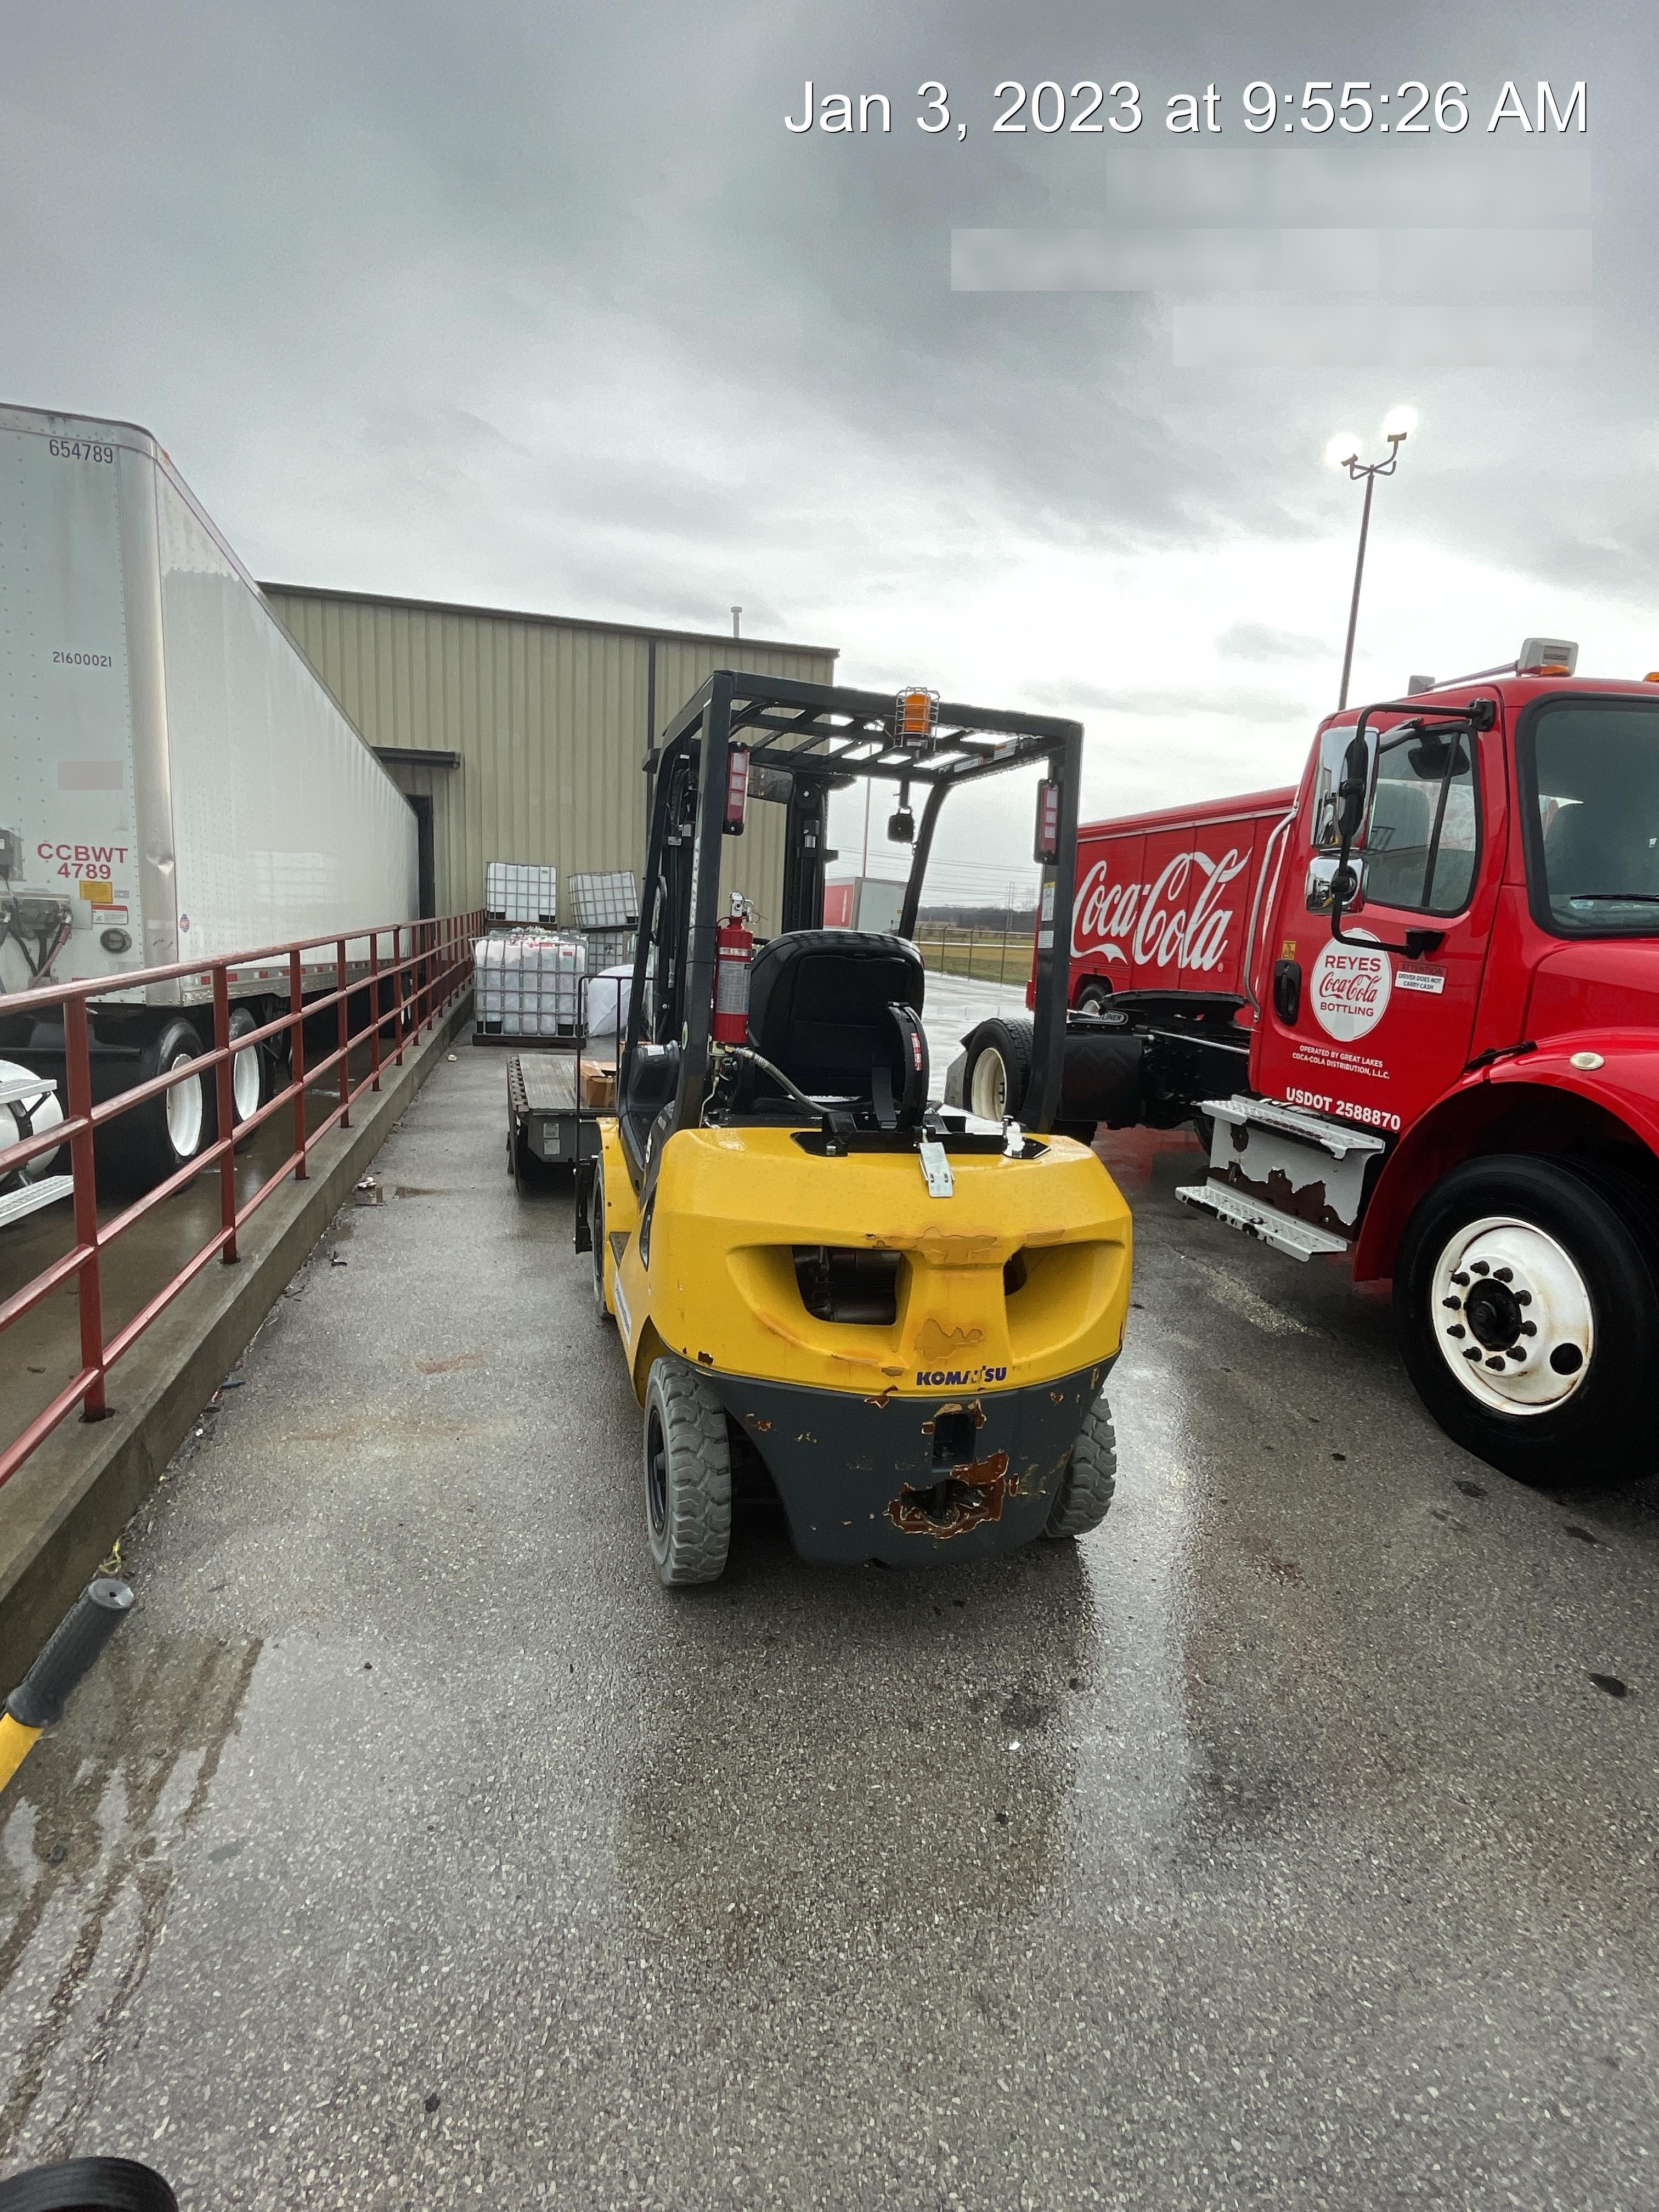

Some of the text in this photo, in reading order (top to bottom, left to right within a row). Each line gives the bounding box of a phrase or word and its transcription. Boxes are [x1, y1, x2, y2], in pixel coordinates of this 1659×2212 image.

[49, 439, 113, 464] 654789
[53, 651, 112, 667] 21600021
[37, 843, 128, 863] CCBWT
[57, 862, 111, 879] 4789
[1070, 847, 1253, 971] Coca-Cola
[1325, 955, 1381, 972] REYES
[1319, 971, 1382, 1003] Coca-Cola
[1320, 1002, 1374, 1017] BOTTLING
[1293, 1052, 1325, 1065] COCA-COLA
[1327, 1059, 1371, 1076] DISTRIBUTION,
[1300, 1045, 1330, 1057] OPERATED
[1340, 1053, 1361, 1063] GREAT
[1362, 1057, 1383, 1068] LAKES
[1286, 1087, 1401, 1130] USDOT 2588870
